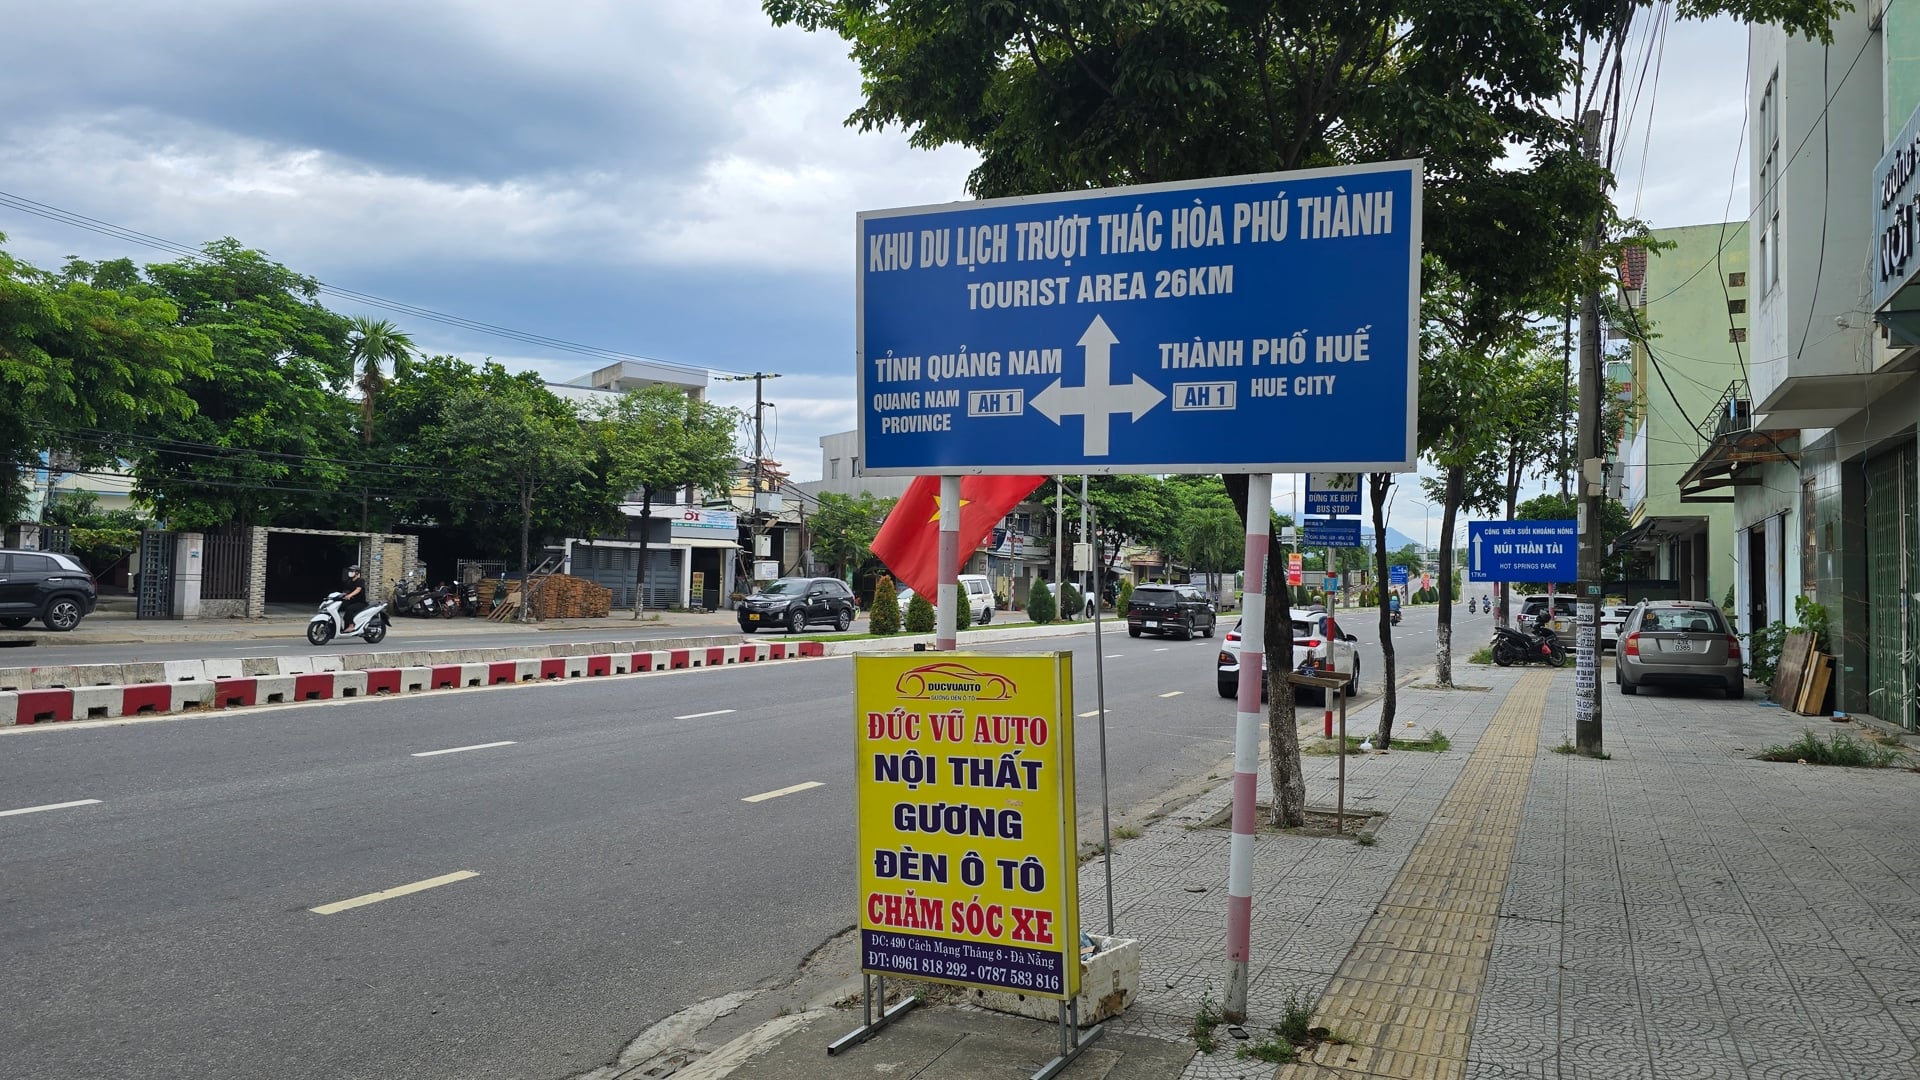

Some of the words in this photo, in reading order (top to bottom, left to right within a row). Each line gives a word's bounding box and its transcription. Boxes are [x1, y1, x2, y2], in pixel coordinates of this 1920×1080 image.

[870, 231, 913, 272] KHU
[921, 228, 950, 268] DU
[956, 224, 1008, 272] LỊCH
[1016, 213, 1091, 267] TRƯỢT
[1098, 203, 1163, 255] THÁC
[1172, 198, 1224, 250] HÒA
[1233, 192, 1288, 243] PHÚ
[1299, 187, 1393, 238] THÀNH
[968, 277, 1070, 309] TOURIST
[1077, 271, 1147, 303] AREA
[1154, 265, 1234, 299] 26KM
[875, 348, 921, 383] TỈNH
[927, 345, 1000, 380] QUẢNG
[1008, 348, 1062, 375] NAM
[1159, 336, 1243, 369] THÀNH
[1252, 329, 1309, 366] PHỐ
[1316, 325, 1373, 363] HUẾ
[874, 392, 920, 411] QUANG
[924, 390, 960, 407] NAM
[978, 395, 1003, 413] AH
[1006, 392, 1014, 412] 1
[1183, 387, 1210, 407] AH
[1216, 386, 1226, 406] 1
[1251, 377, 1289, 397] HUE
[1294, 376, 1336, 396] CITY
[882, 415, 951, 434] PROVINCE
[1494, 542, 1512, 554] NÚI
[1515, 541, 1542, 554] THẦN
[1546, 542, 1563, 554] TÀI
[1518, 526, 1530, 535] SUỐI
[1533, 526, 1555, 535] KHOÁNG
[928, 684, 981, 692] DUCVUAUTO
[868, 708, 920, 740] ĐỨC
[929, 710, 964, 741] VŨ
[974, 716, 1047, 745] AUTO
[874, 750, 936, 789] NỘI
[948, 750, 1042, 790] THẤT
[894, 803, 1022, 839] GƯƠNG
[874, 847, 947, 884] ĐÈN
[961, 852, 984, 886] Ô
[997, 856, 1045, 893] TÔ
[868, 890, 944, 931] CHĂM
[952, 896, 1003, 938] SÓC
[1011, 908, 1053, 944] XE
[872, 934, 889, 947] ĐC:
[890, 937, 906, 948] 490
[908, 938, 931, 952] Cách
[934, 942, 960, 958] Mạng
[963, 945, 994, 962] Tháng
[996, 950, 1002, 960] 8
[1011, 951, 1024, 963] Đà
[1028, 952, 1054, 970] Nẵng
[869, 952, 889, 967] ĐT:
[892, 955, 918, 970] 0961
[923, 959, 943, 974] 818
[946, 962, 967, 977] 292
[978, 966, 1007, 982] 0787
[1011, 970, 1032, 987] 583
[1036, 975, 1059, 990] 816
